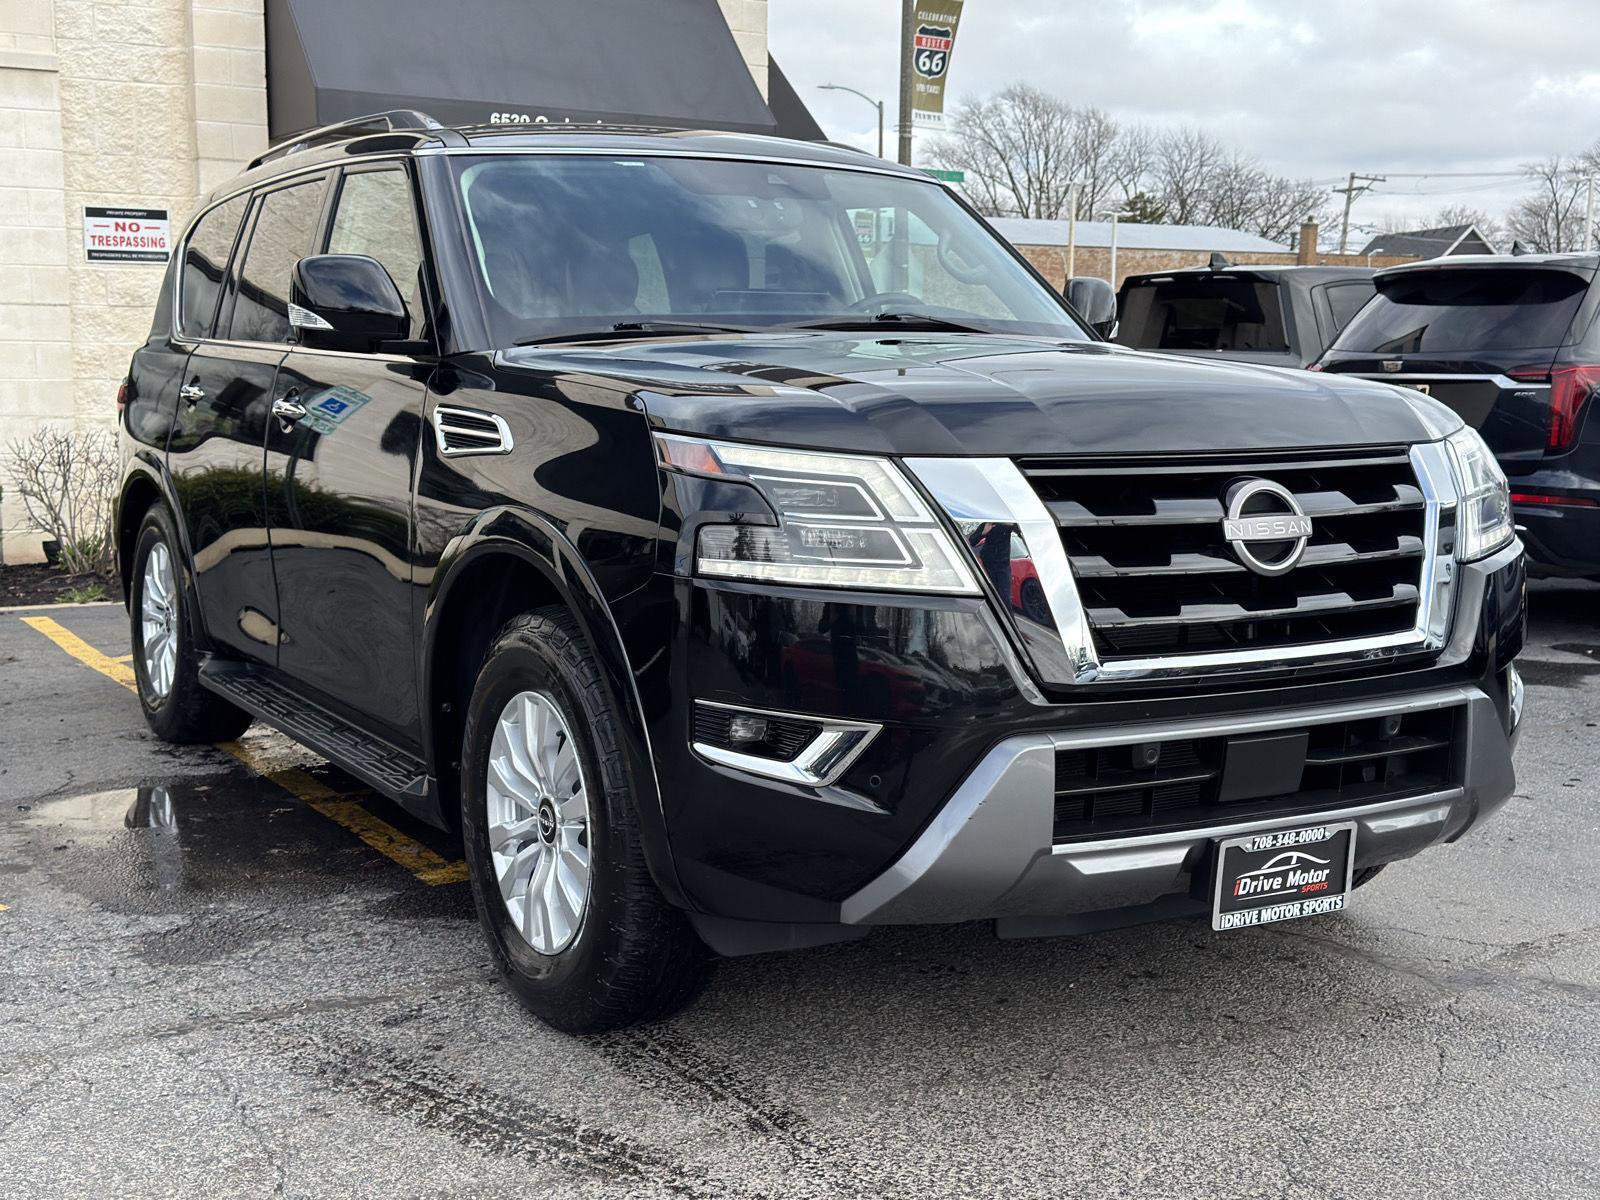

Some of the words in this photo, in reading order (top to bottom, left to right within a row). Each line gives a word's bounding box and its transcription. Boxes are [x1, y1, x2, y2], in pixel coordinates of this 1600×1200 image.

[918, 11, 957, 23] CELEBRATING
[921, 37, 945, 49] ROUTE
[918, 51, 944, 72] 66
[114, 222, 141, 233] NO
[90, 235, 166, 249] TRESPASSING
[1227, 521, 1311, 537] NISSAN
[1253, 828, 1325, 850] 708-348-0000
[1233, 875, 1282, 897] iDrive
[1286, 869, 1330, 888] Motor
[1301, 881, 1329, 894] SPORTS
[1260, 906, 1300, 923] MOTOR
[1302, 895, 1344, 914] SPORTS
